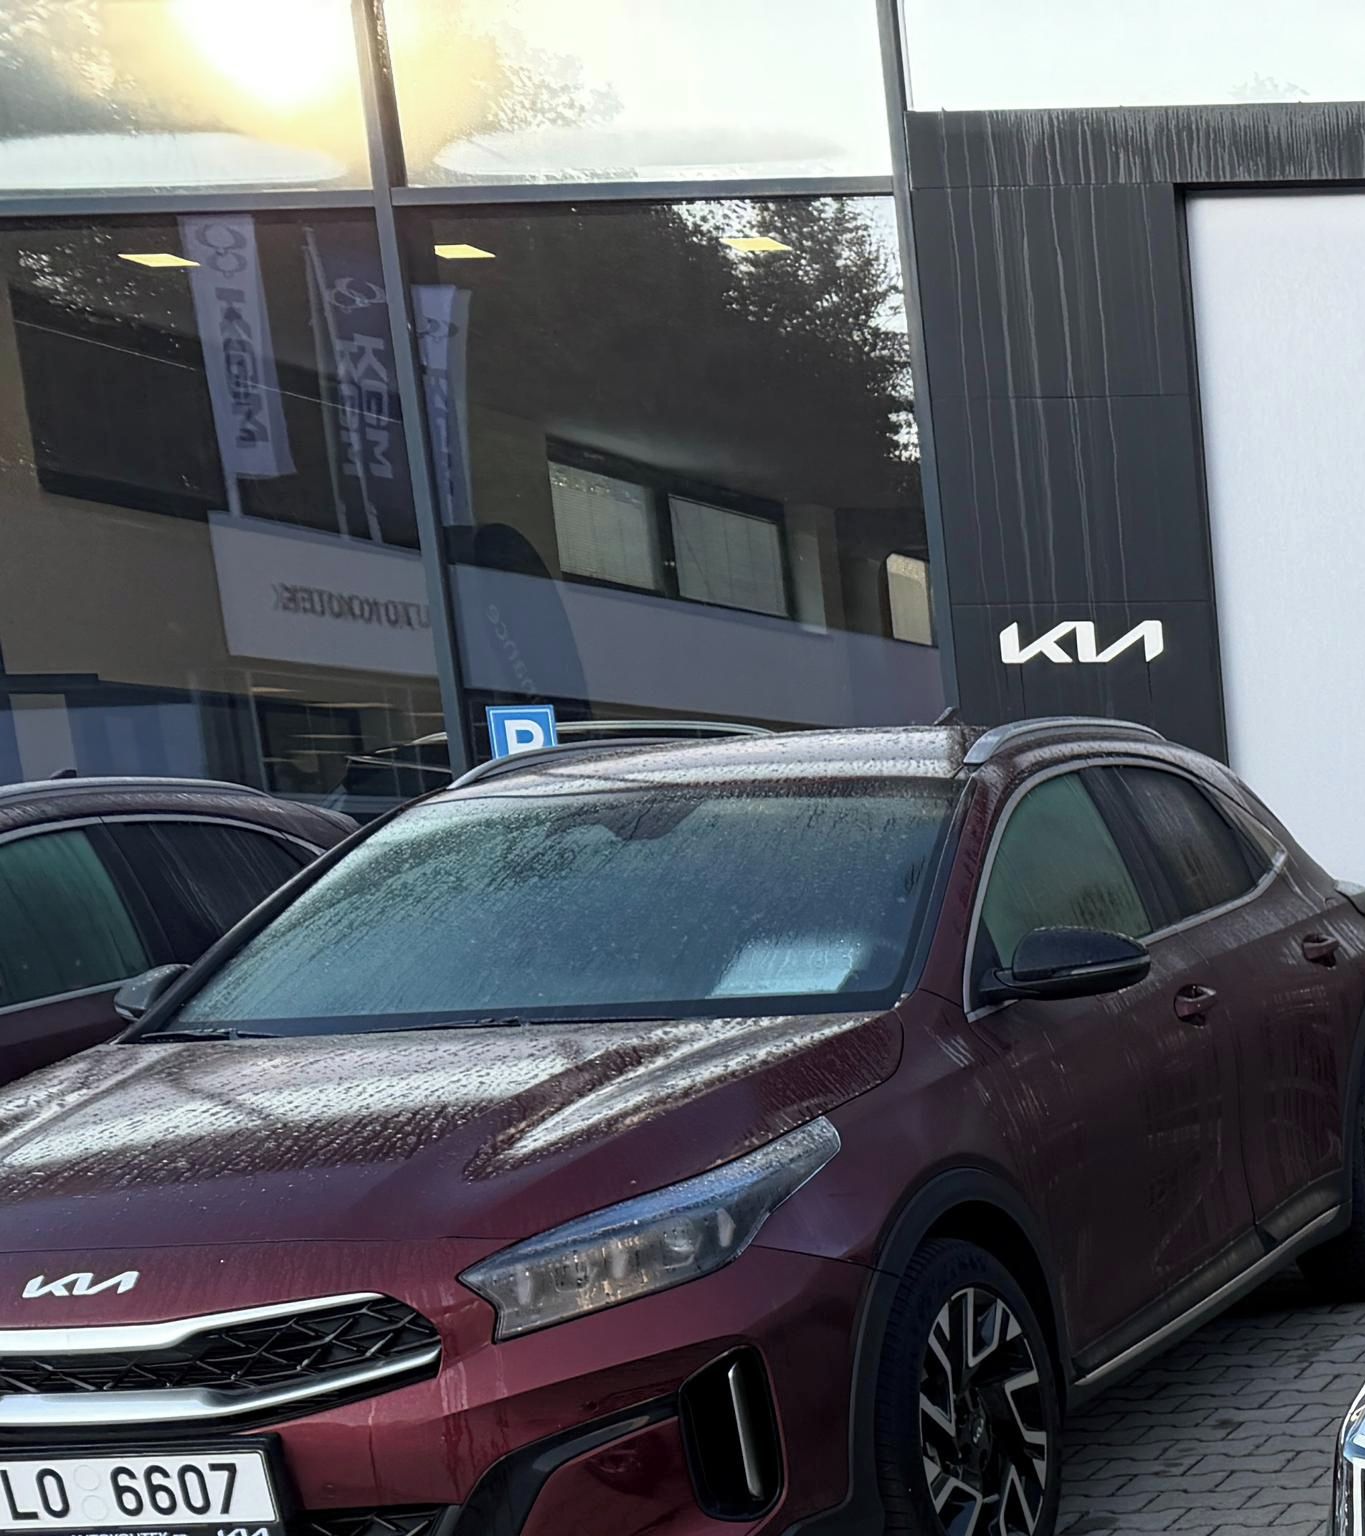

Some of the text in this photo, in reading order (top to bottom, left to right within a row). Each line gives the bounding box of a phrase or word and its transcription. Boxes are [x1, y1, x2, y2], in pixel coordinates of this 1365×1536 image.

[999, 620, 1164, 664] KIA
[504, 719, 545, 756] P
[22, 1271, 140, 1299] KIA
[109, 1462, 238, 1518] 6607
